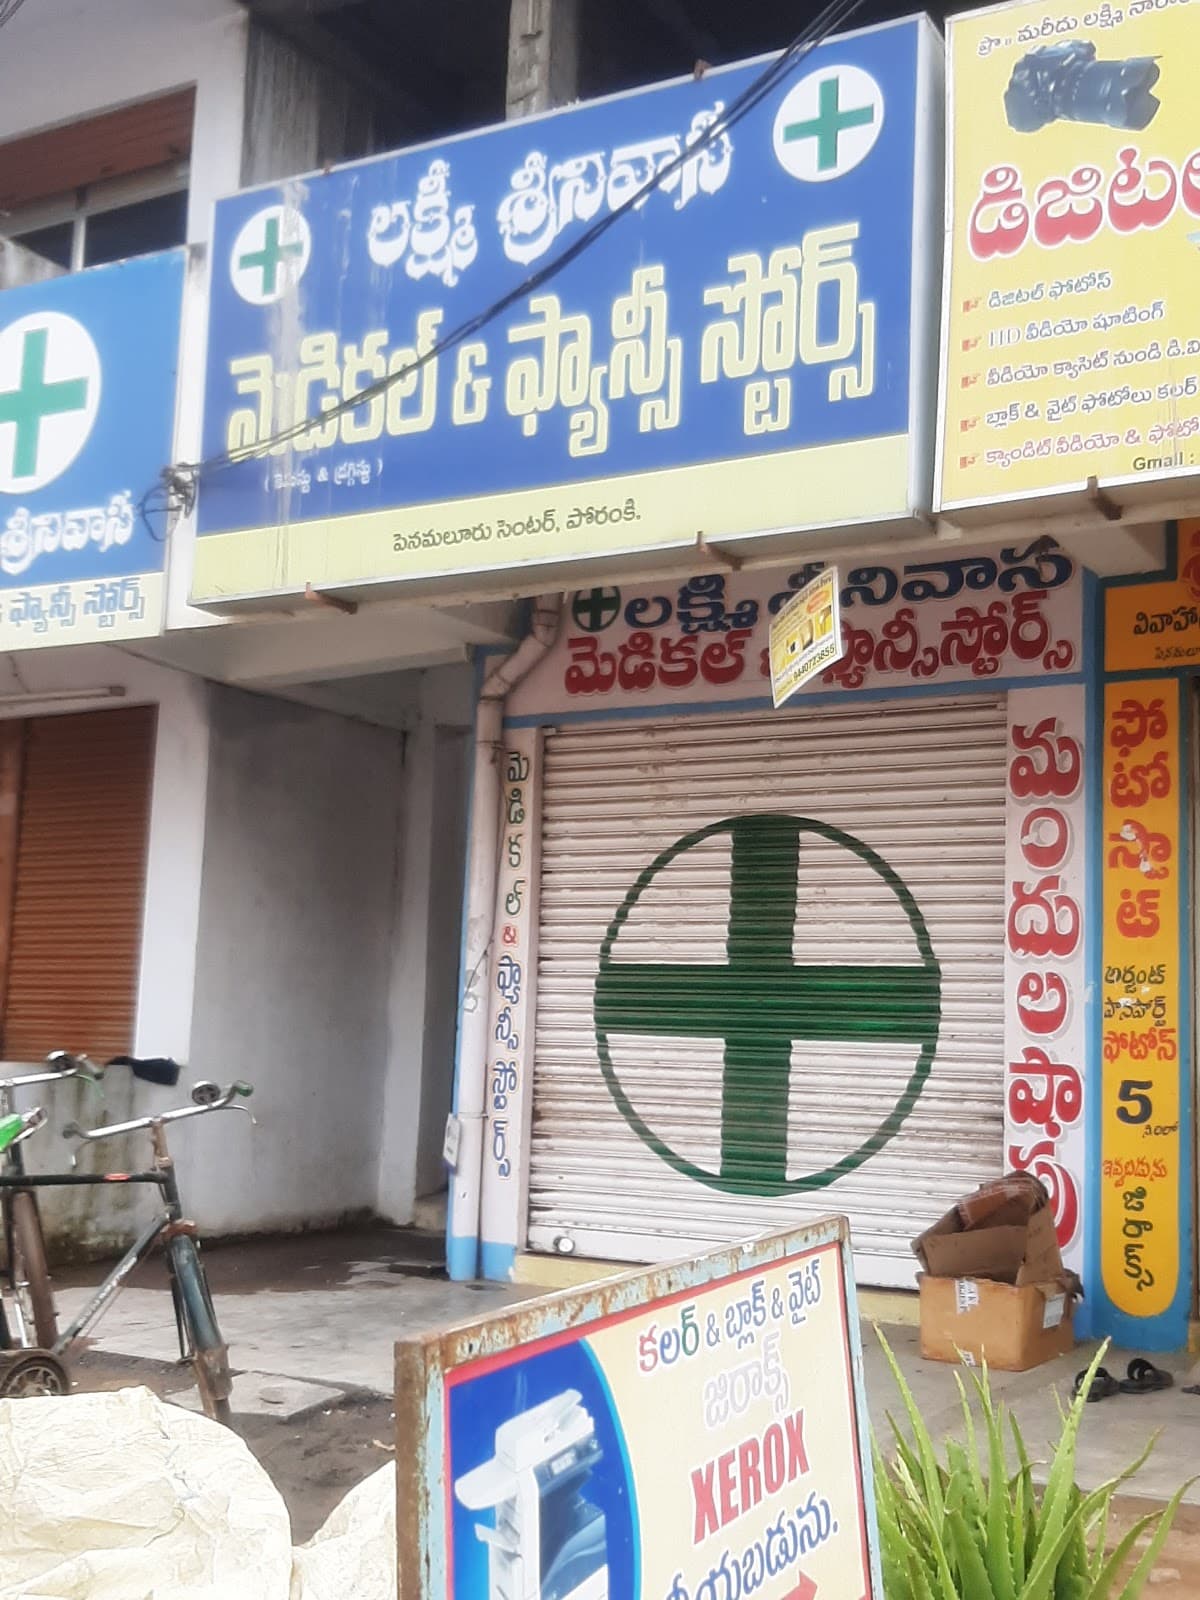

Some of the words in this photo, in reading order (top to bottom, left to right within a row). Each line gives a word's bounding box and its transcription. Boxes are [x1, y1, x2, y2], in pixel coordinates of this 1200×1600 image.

[969, 147, 1200, 260] డిజిట
[988, 283, 1044, 309] డిజిటల్
[1049, 271, 1112, 299] ఫోటోస్
[1113, 341, 1161, 366] నుండి
[452, 342, 492, 426] &
[1025, 402, 1040, 419] &
[1081, 386, 1152, 412] ఫోటోలు
[1125, 428, 1141, 445] &
[1133, 452, 1183, 471] Gmail
[393, 522, 492, 552] పెనమలూరు
[564, 628, 752, 694] మెడికల్
[503, 925, 517, 944] &
[1116, 1079, 1153, 1125] 5
[639, 1303, 700, 1373] కలర్
[705, 1312, 721, 1347] &
[771, 1287, 785, 1319] &
[690, 1408, 811, 1546] XEROX
